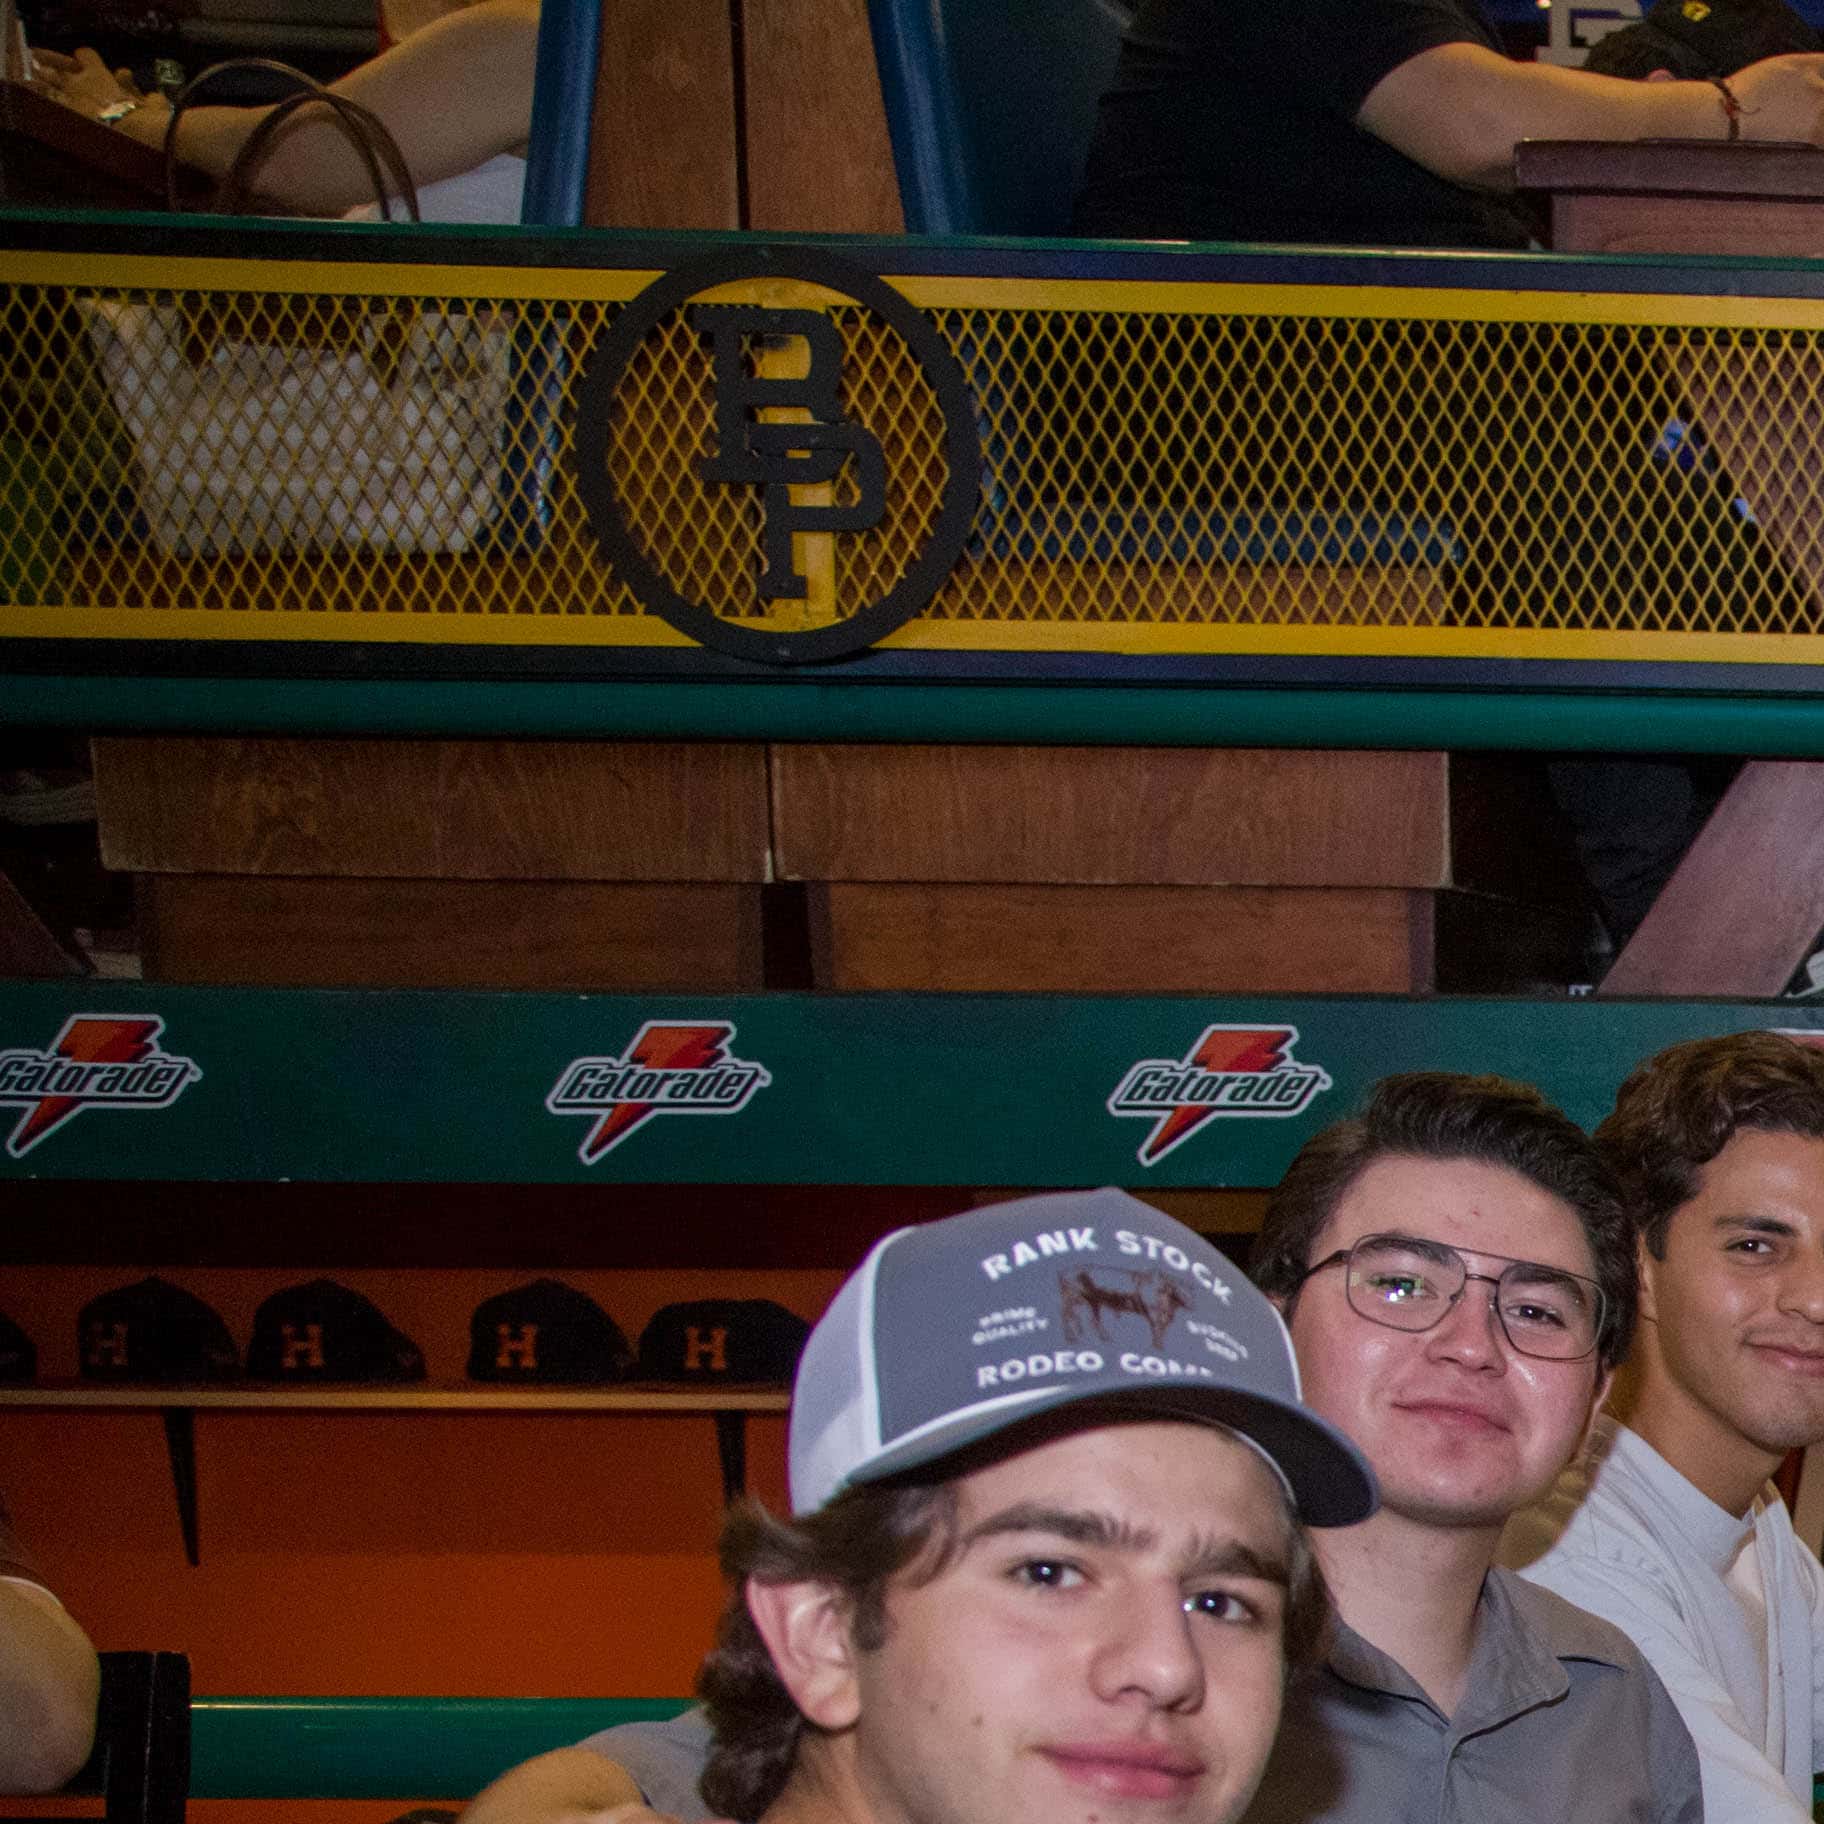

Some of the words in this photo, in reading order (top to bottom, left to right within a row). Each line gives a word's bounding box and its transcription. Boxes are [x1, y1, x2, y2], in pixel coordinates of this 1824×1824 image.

[0, 1058, 172, 1094] Gatorade
[562, 1067, 748, 1100] Gatorade
[1122, 1069, 1309, 1102] Gatorade
[981, 1226, 1099, 1282] RANK
[1114, 1229, 1233, 1306] STOCK
[88, 1320, 130, 1367] H
[281, 1322, 324, 1369] H
[496, 1323, 538, 1370] H
[684, 1325, 728, 1371] H
[976, 1350, 1105, 1390] RODEO
